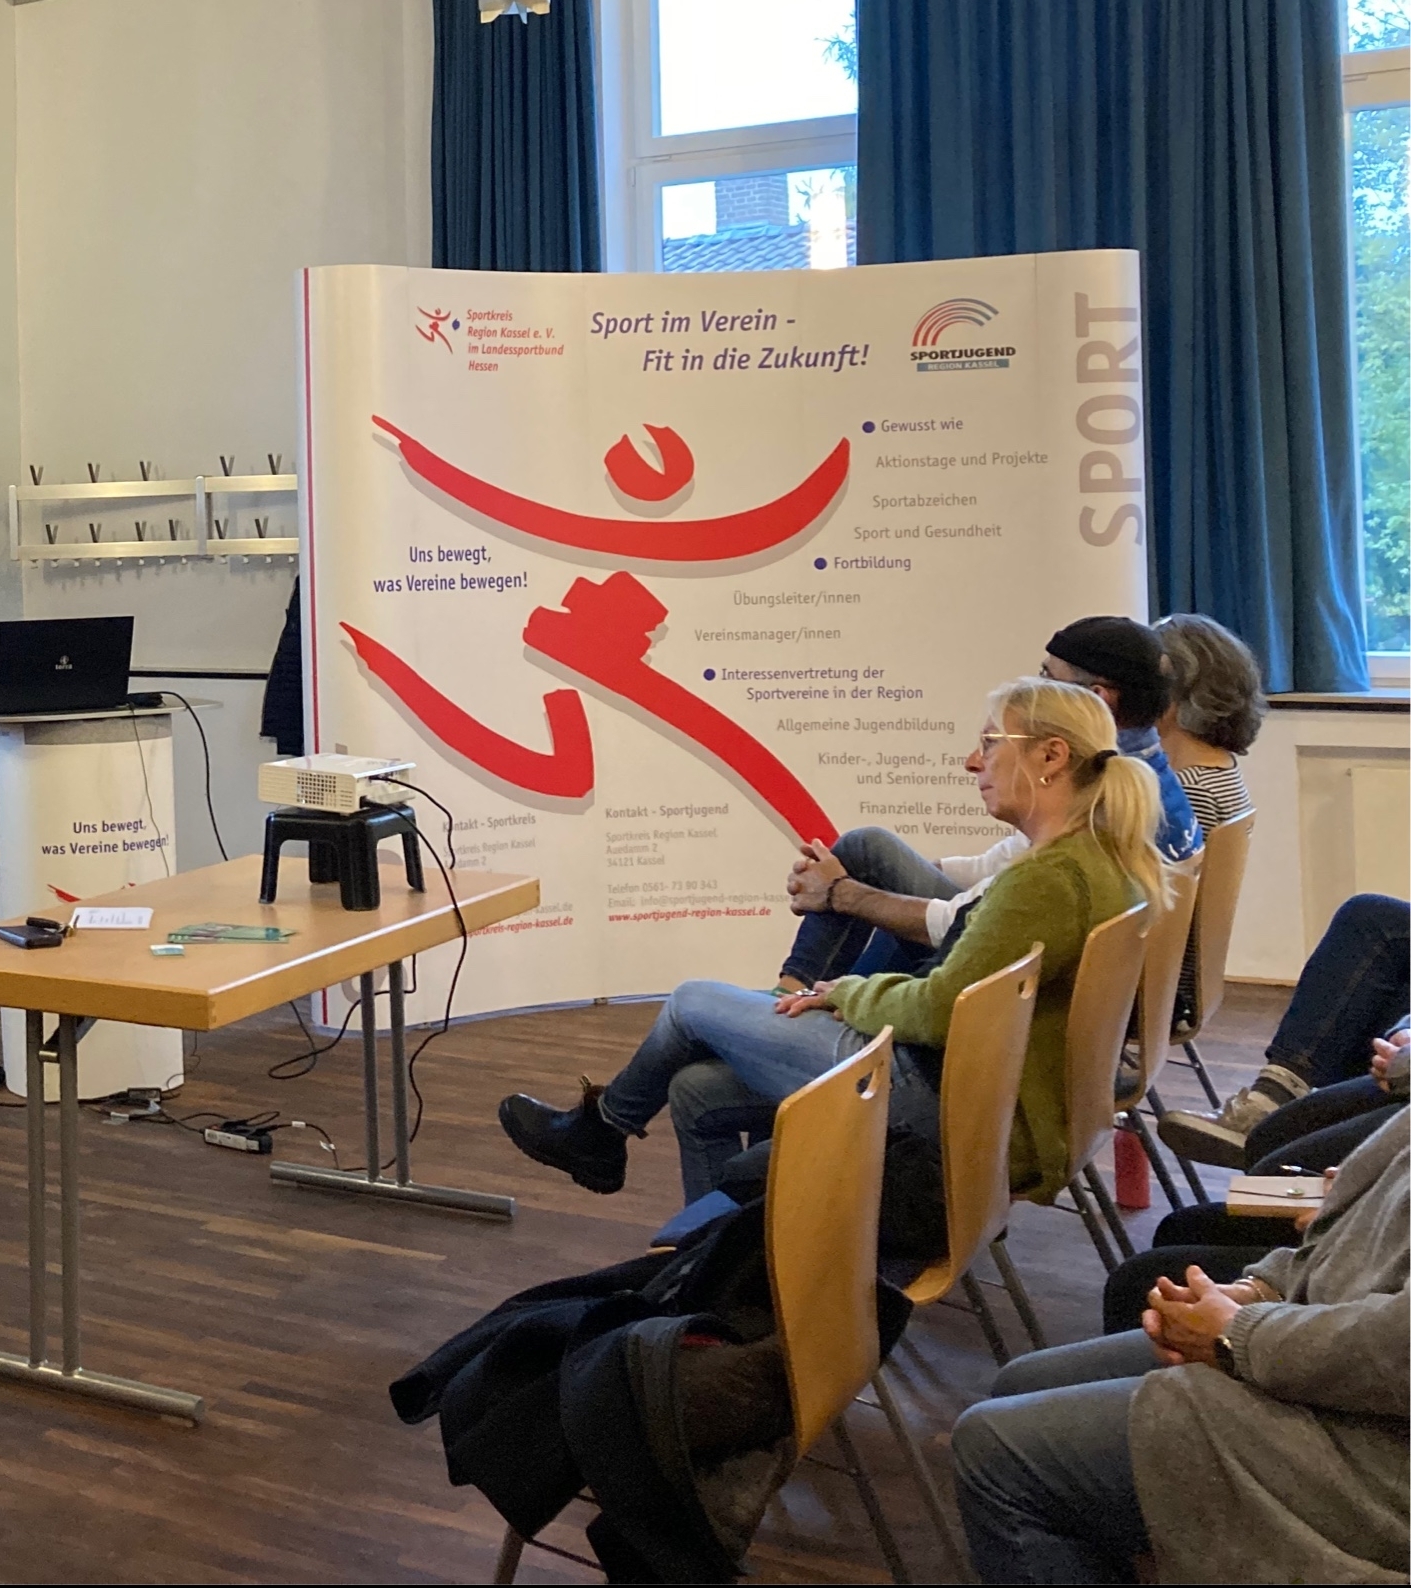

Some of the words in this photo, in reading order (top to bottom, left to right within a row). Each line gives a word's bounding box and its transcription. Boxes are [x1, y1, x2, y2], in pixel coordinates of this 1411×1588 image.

[466, 309, 513, 322] Sportkreis
[591, 312, 654, 339] Sport
[661, 311, 691, 333] im
[701, 308, 777, 332] Verein
[468, 326, 497, 339] Region
[500, 328, 530, 339] Kassel
[468, 343, 479, 354] im
[481, 344, 564, 357] Landessportbund
[643, 349, 674, 372] Fit
[681, 348, 704, 371] in
[713, 347, 751, 370] die
[758, 344, 870, 372] Zukunft!
[910, 346, 1016, 362] SPORTJUGEND
[468, 360, 498, 371] Hessen
[927, 362, 963, 371] REGION
[964, 360, 1000, 370] KASSEL
[881, 419, 936, 433] Gewusst
[940, 418, 964, 431] wie
[1074, 292, 1144, 547] SPORT
[875, 454, 957, 470] Aktionstage
[961, 453, 987, 467] und
[992, 452, 1049, 468] Projekte
[873, 493, 977, 510] Sportabzeichen
[854, 526, 891, 542] Sport
[894, 526, 920, 539] und
[924, 524, 1002, 538] Gesundheit
[409, 546, 433, 563] Uns
[437, 545, 492, 565] bewegt,
[834, 557, 911, 571] Fortbildung
[373, 578, 402, 593] was
[406, 574, 456, 592] Vereine
[460, 571, 528, 592] bewegen!
[733, 590, 861, 608] Übungsleiter/innen
[694, 628, 841, 643] Vereinsmanager/innen
[721, 667, 858, 681] Interessenvertretung
[863, 667, 885, 680] der
[746, 687, 829, 702] Sportvereine
[833, 687, 847, 700] in
[851, 687, 873, 700] der
[877, 686, 923, 702] Region
[776, 718, 850, 734] Allgemeine
[853, 718, 955, 734] Jugendbildung
[876, 752, 936, 769] Jugend-,
[857, 773, 882, 785] und
[887, 773, 977, 786] Seniorenfreiz
[605, 807, 649, 819] Kontakt
[659, 803, 729, 819] Sportjugend
[860, 801, 932, 815] Finanzielle
[937, 802, 989, 817] Förderu
[73, 821, 98, 834] Uns
[102, 818, 147, 833] bewegt,
[487, 812, 536, 830] Sportkreis
[606, 831, 651, 843] Sportkreis
[654, 830, 685, 842] Region
[687, 828, 718, 839] Kassel
[894, 824, 919, 835] von
[42, 844, 66, 855] was
[69, 841, 119, 855] Vereine
[122, 834, 170, 852] bewegen!
[482, 841, 509, 854] Region
[510, 838, 536, 850] Kassel
[652, 843, 658, 853] 2
[607, 857, 634, 867] 34121
[637, 855, 665, 866] Kassel
[607, 883, 640, 894] Telefon
[640, 893, 789, 908] info@sportjugend-region-kasse
[608, 906, 772, 922] www.sportjugend-region-kassel.de
